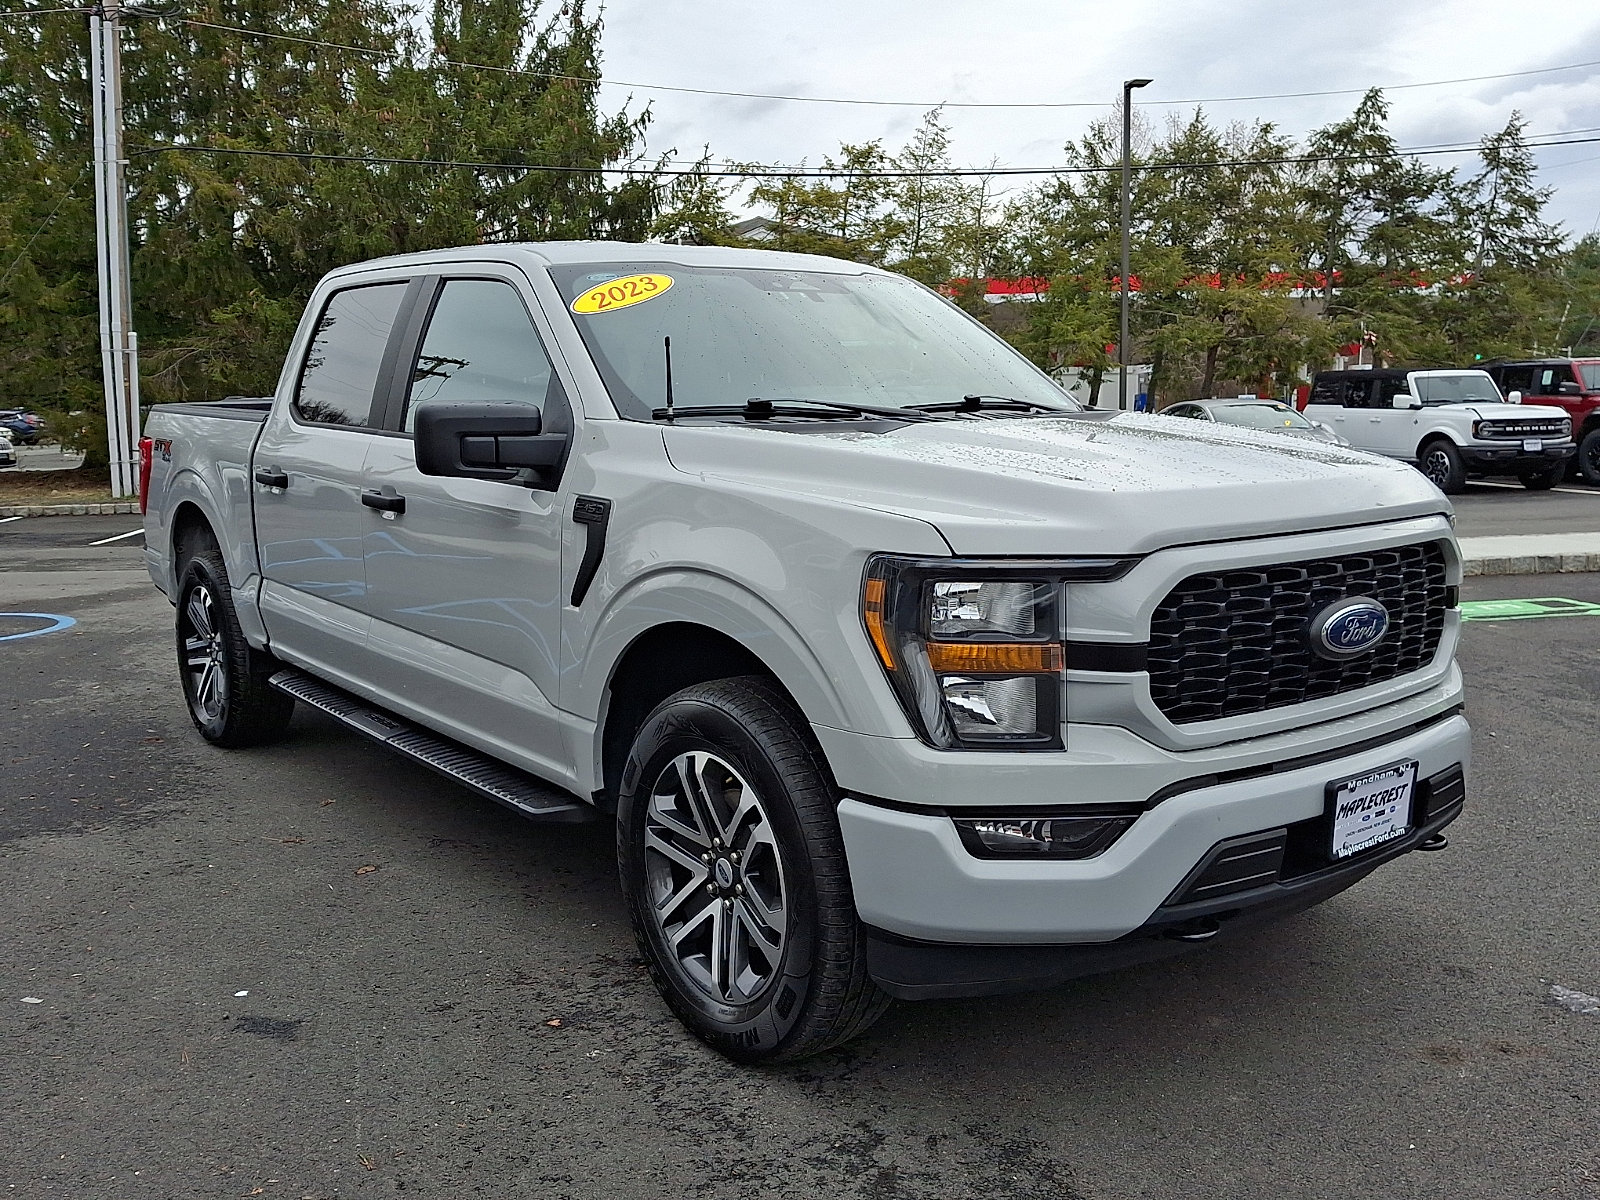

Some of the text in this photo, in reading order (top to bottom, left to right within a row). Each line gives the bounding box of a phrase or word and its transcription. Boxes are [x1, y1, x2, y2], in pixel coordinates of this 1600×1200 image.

[590, 276, 658, 309] 2023
[154, 438, 173, 457] STX
[1341, 614, 1377, 644] Ford
[1399, 764, 1411, 774] NJ
[1336, 783, 1409, 821] MAPLECREST
[1337, 827, 1406, 858] MaplecrestFord.com
